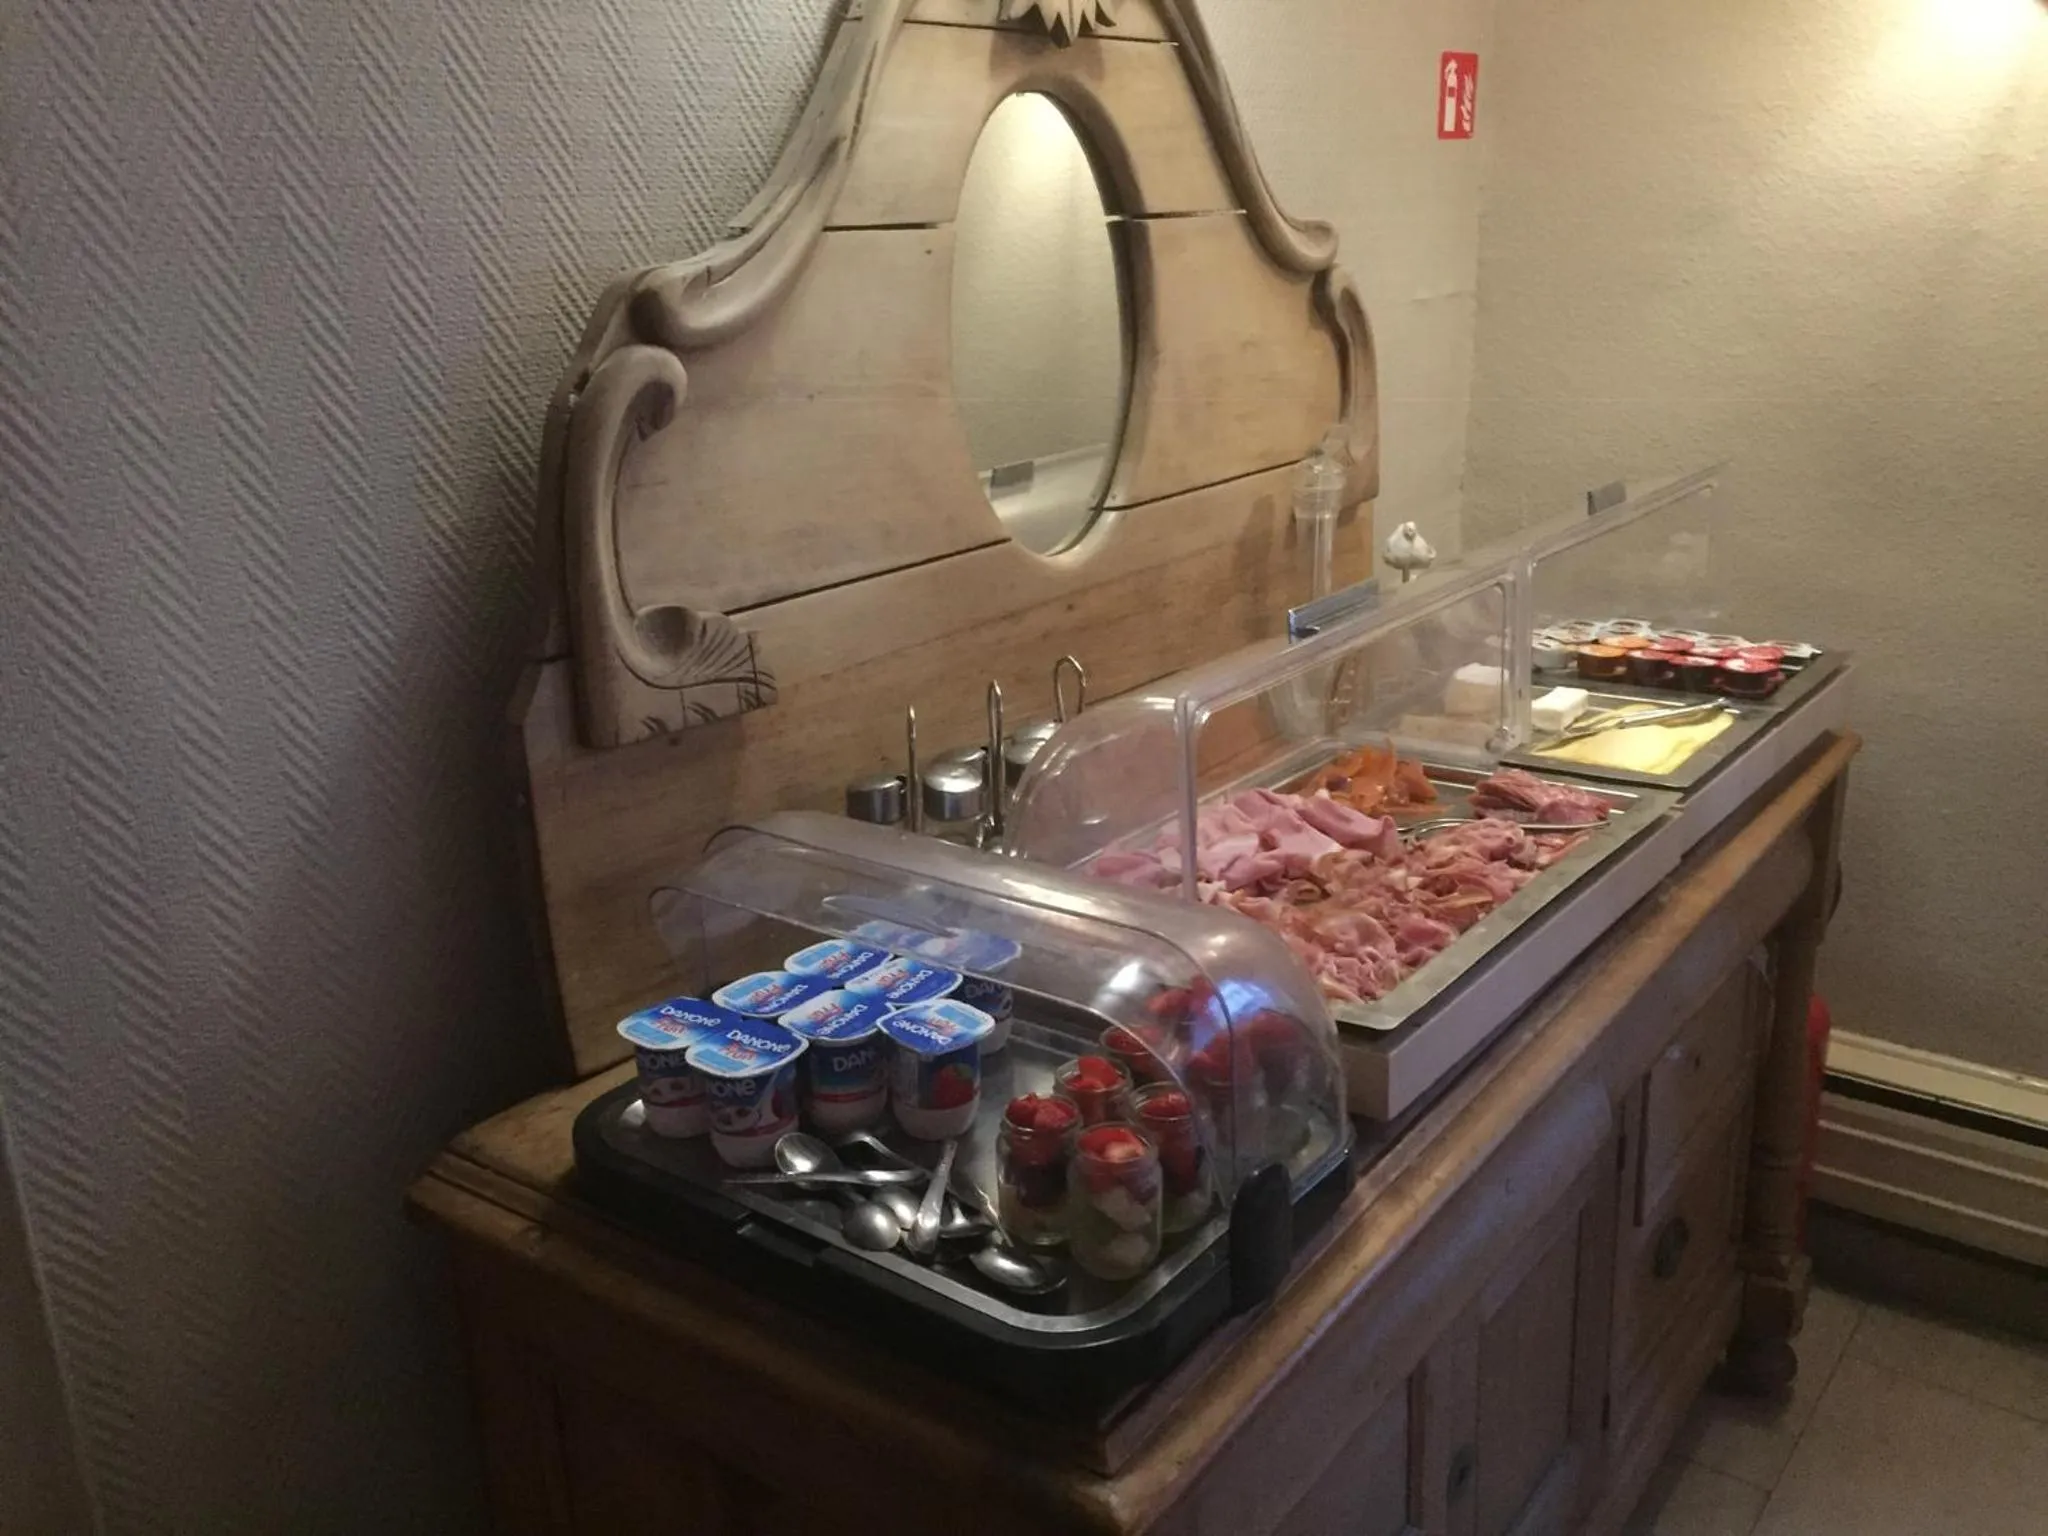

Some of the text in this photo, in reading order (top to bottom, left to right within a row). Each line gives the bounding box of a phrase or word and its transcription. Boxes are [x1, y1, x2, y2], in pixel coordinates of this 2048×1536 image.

[660, 1005, 721, 1027] DANONE
[815, 1004, 869, 1036] DANONE
[726, 1029, 791, 1051] DANONE
